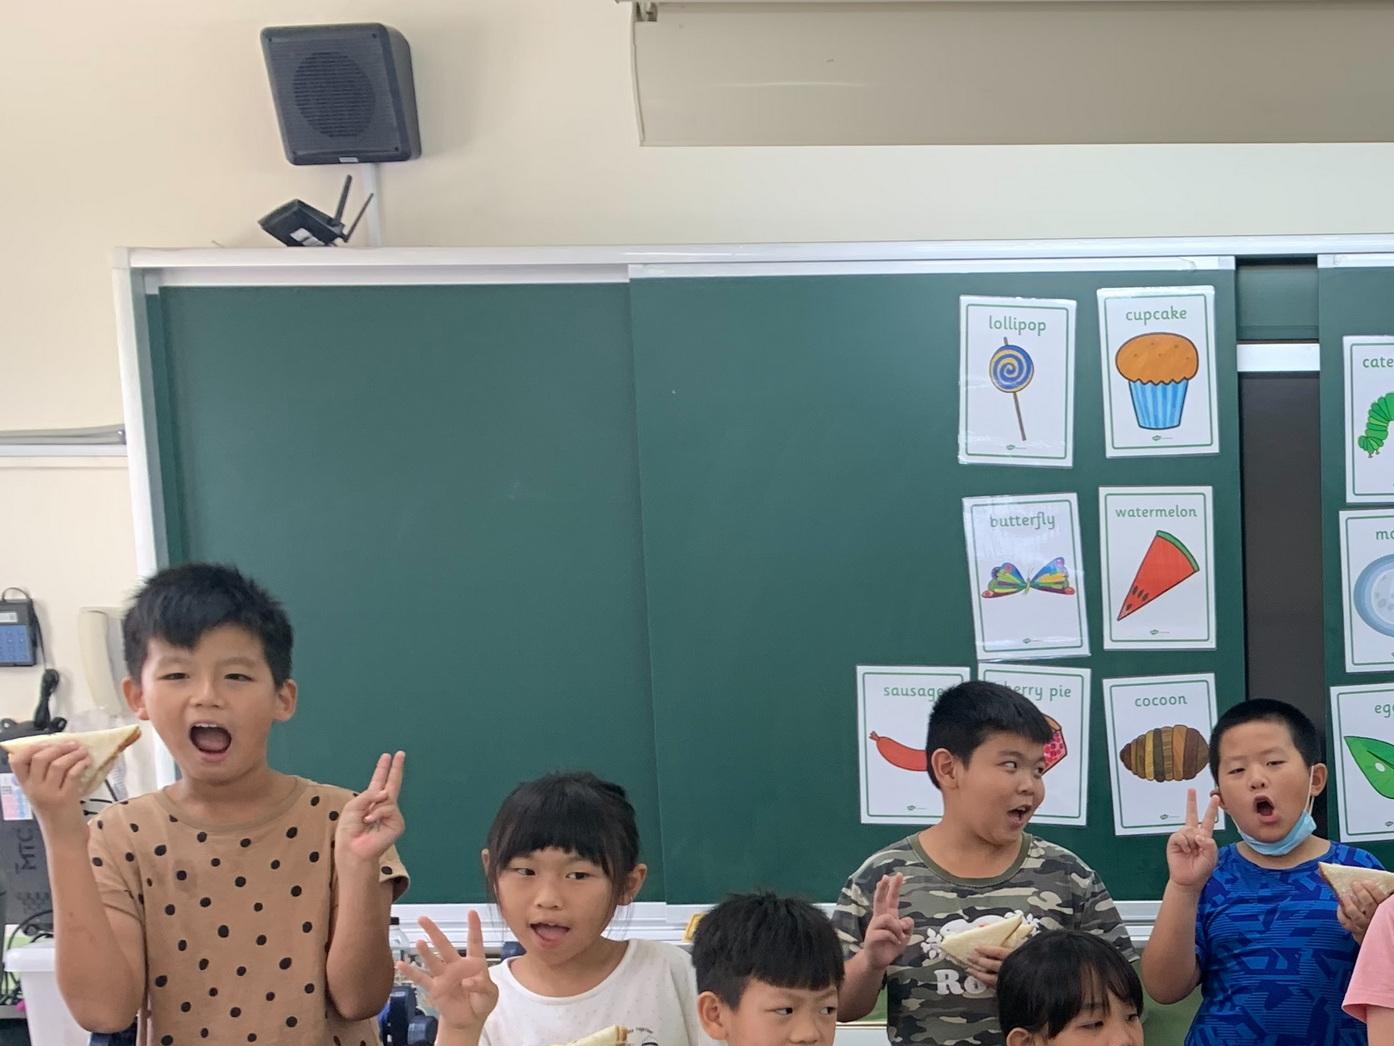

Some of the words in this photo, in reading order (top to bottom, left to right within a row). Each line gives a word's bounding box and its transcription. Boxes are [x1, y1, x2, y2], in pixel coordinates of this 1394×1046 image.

[1125, 305, 1188, 326] cupcake
[988, 314, 1047, 338] lollipop
[1114, 504, 1198, 518] watermelon
[988, 510, 1056, 532] butterfly
[1049, 684, 1072, 702] pie
[1134, 694, 1188, 708] cocoon
